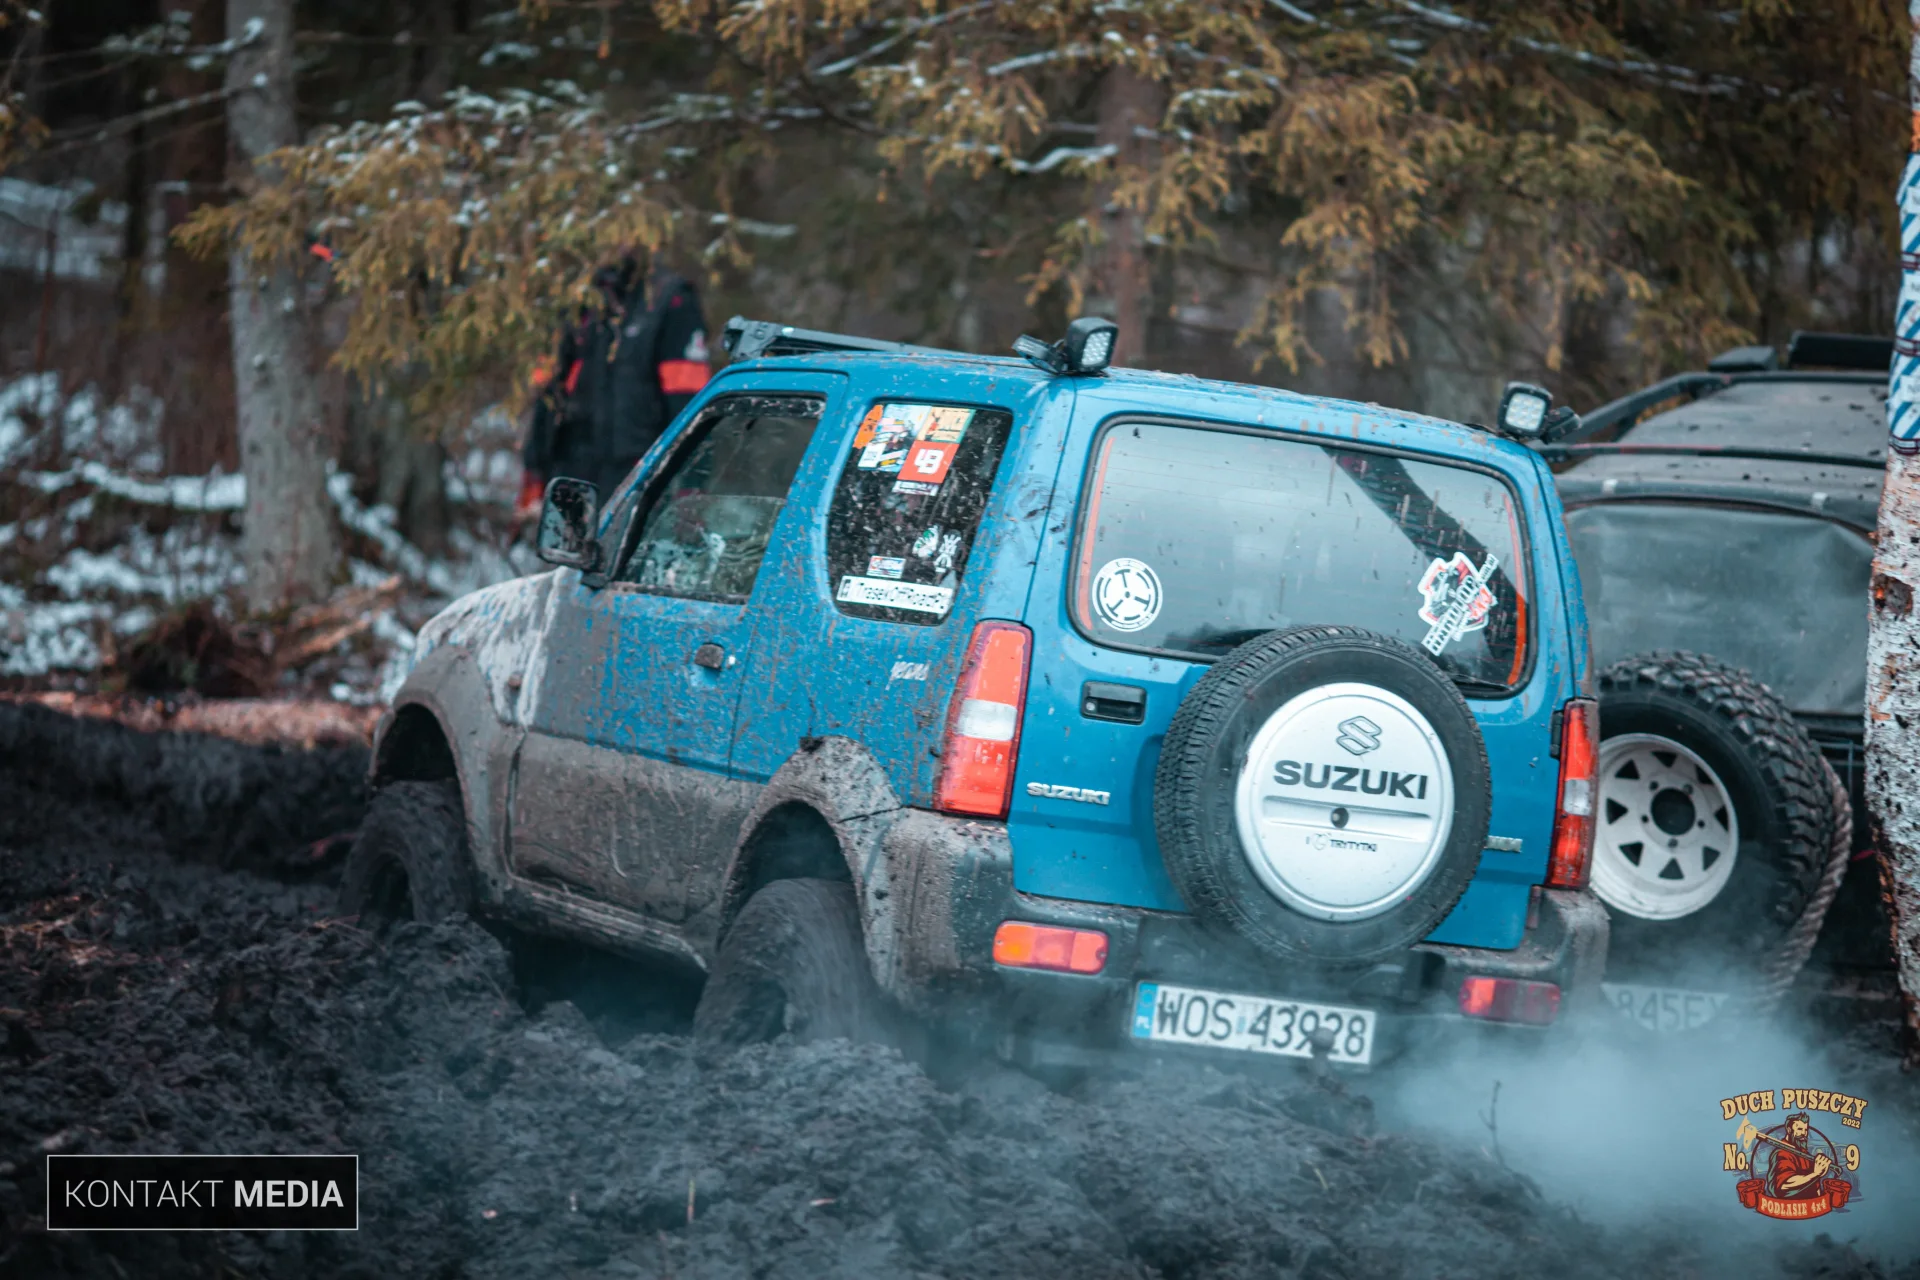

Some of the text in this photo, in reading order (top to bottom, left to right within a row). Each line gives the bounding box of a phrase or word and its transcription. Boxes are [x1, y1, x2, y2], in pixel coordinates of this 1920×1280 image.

[1027, 782, 1111, 805] SUZUKI
[1273, 760, 1428, 800] SUZUKI
[1156, 991, 1367, 1057] WOS 43928
